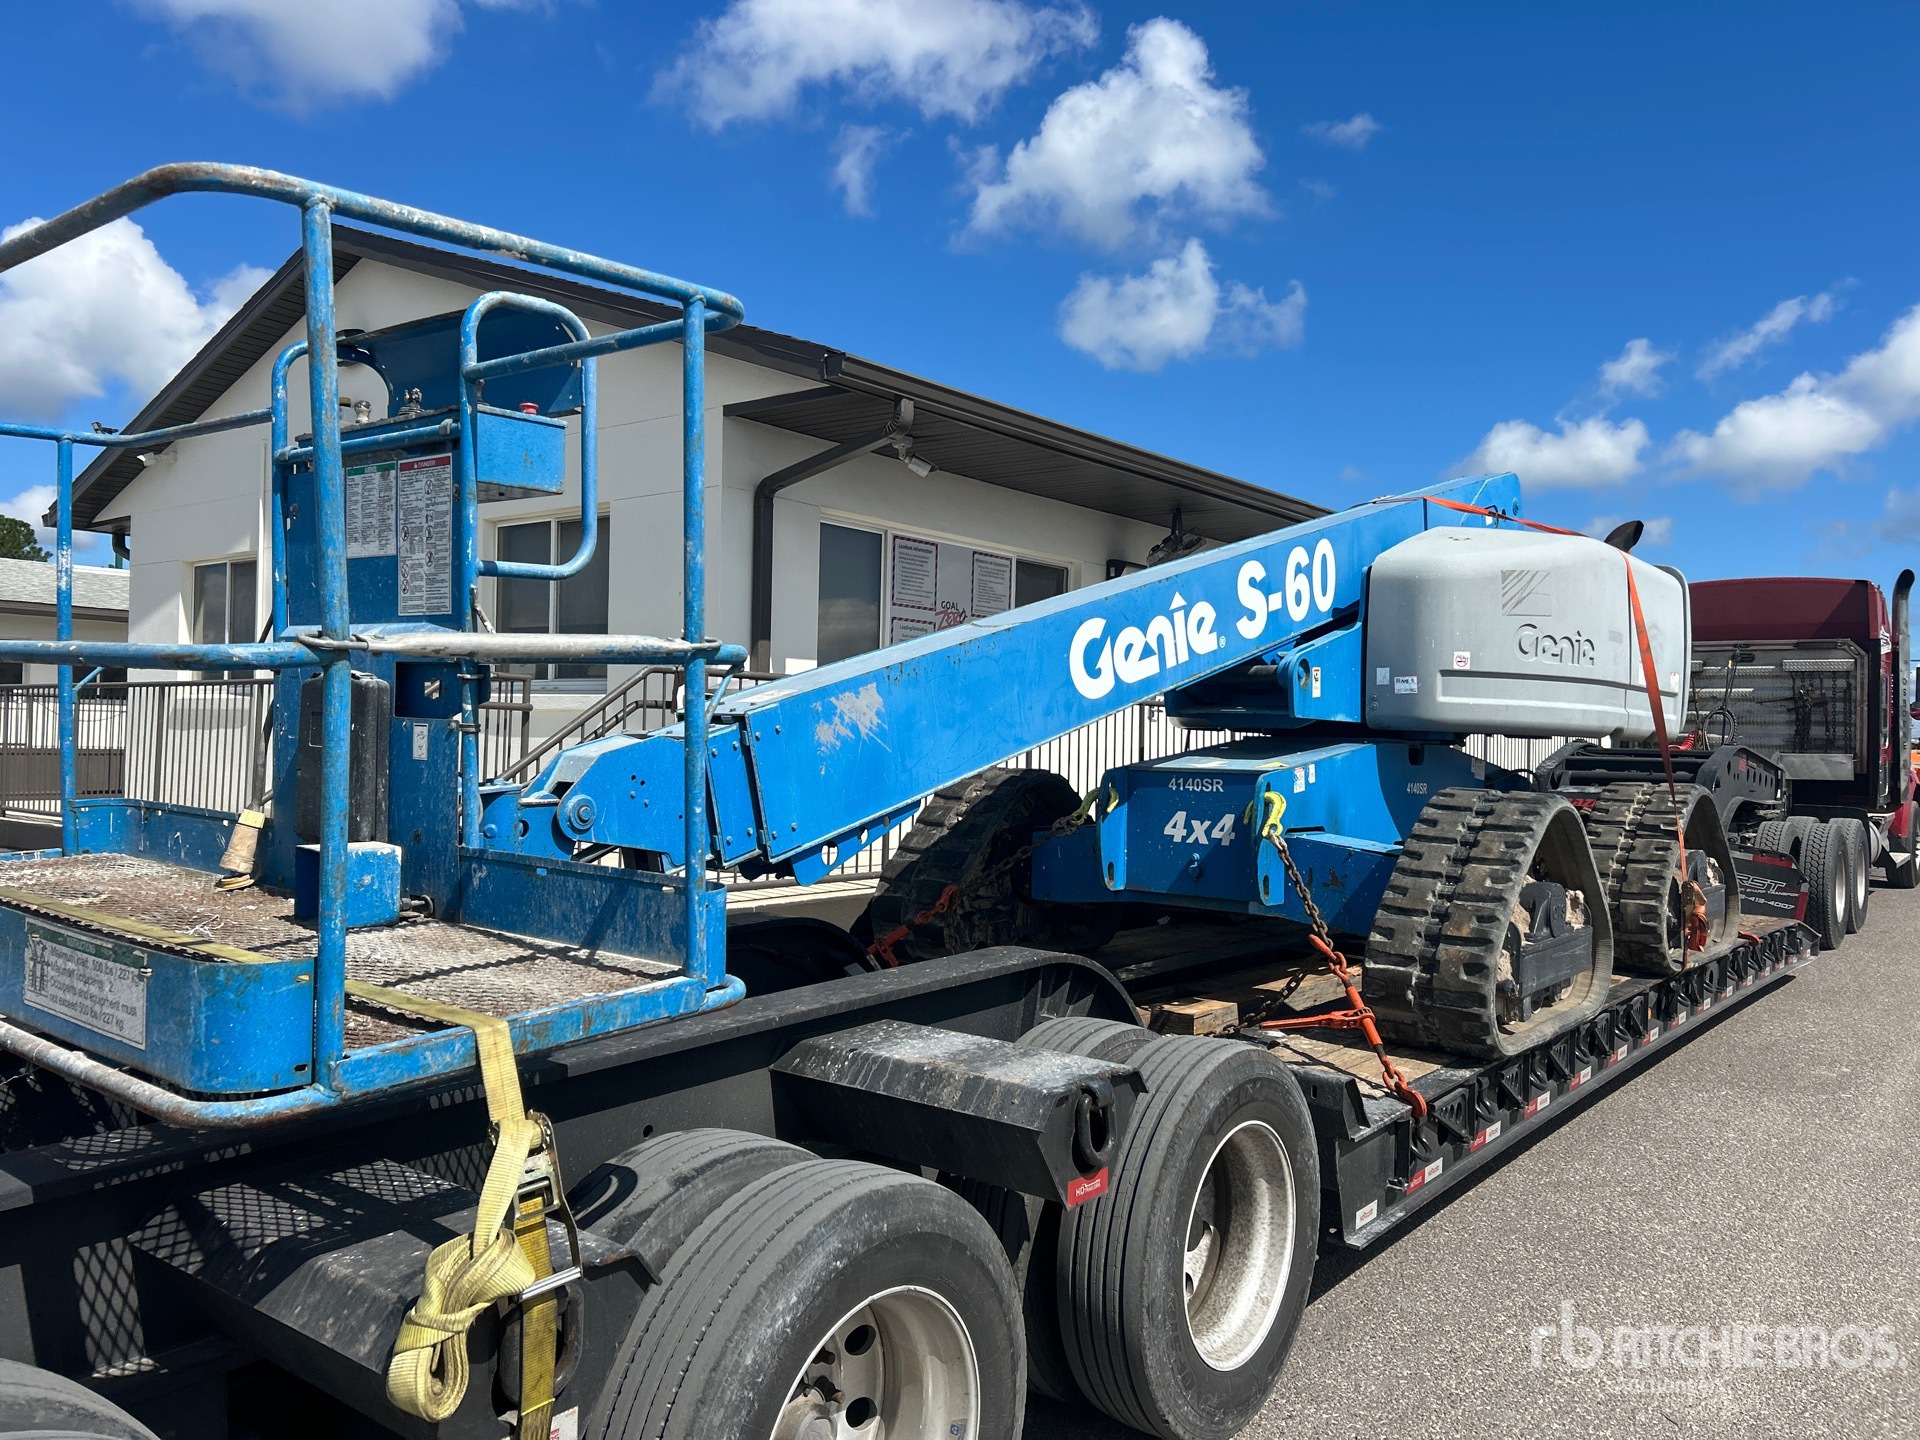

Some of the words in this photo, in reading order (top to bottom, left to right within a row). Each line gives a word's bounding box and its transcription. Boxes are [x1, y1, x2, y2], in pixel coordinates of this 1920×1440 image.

[1236, 538, 1336, 640] S-60
[941, 600, 959, 611] GOAL
[935, 608, 968, 630] ZERO
[1069, 591, 1218, 700] Genie
[1515, 622, 1595, 667] Genie
[1168, 777, 1225, 793] 4140SR
[1406, 782, 1428, 795] 4140SR
[1163, 810, 1236, 847] 4x4
[1075, 1186, 1085, 1196] HD
